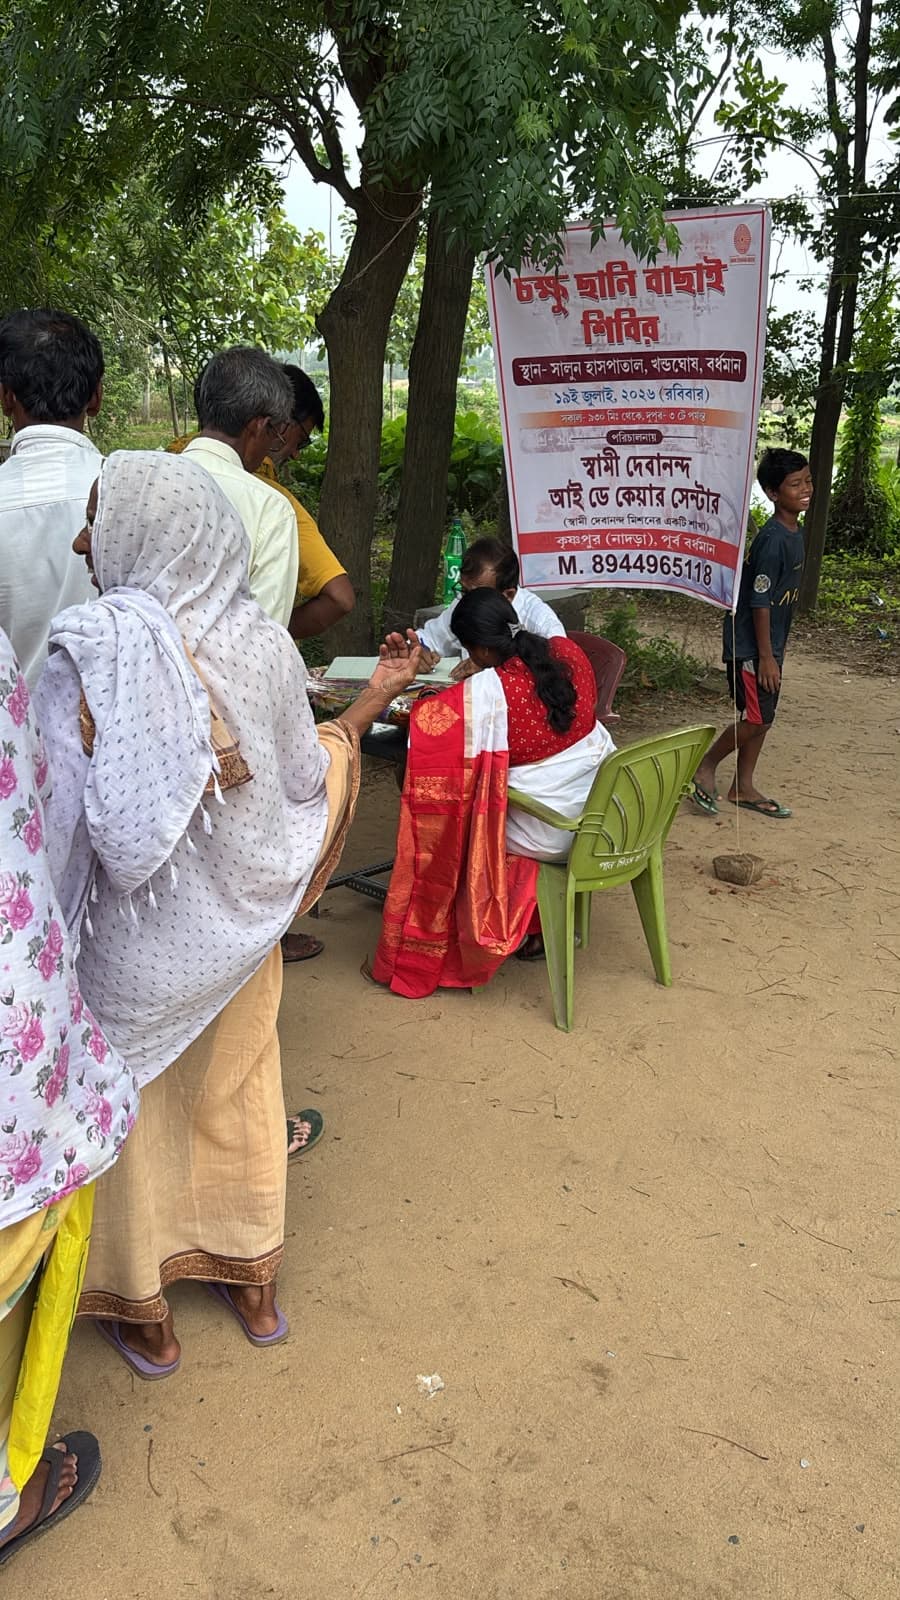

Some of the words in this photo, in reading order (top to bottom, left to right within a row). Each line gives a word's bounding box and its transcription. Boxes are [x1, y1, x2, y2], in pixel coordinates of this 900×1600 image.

[513, 274, 570, 318] চক্ষু
[574, 260, 637, 302] ছানি
[643, 255, 729, 298] বাছাই
[581, 306, 660, 346] শিবির
[518, 361, 548, 383] স্থান-
[550, 360, 583, 381] সালুন
[584, 358, 648, 377] হাসপাতাল,
[705, 351, 742, 376] বর্ধমান
[554, 387, 578, 405] ১৯ই
[581, 386, 617, 408] জুলাই,
[620, 387, 656, 402] ২০২৬
[659, 383, 710, 404] (রবিবার)
[611, 431, 657, 444] পরিচালনায়
[581, 447, 620, 480] স্বামী
[626, 452, 692, 479] দেবানন্দ
[548, 479, 585, 512] আই
[589, 486, 610, 509] ডে
[615, 483, 666, 509] কেয়ার
[671, 481, 721, 515] সেন্টার
[563, 513, 588, 528] (স্বামী
[590, 515, 625, 526] দেবানন্দ
[627, 513, 662, 526] মিশনের
[664, 516, 687, 528] একটি
[555, 533, 601, 549] কৃষ্ণপুর
[684, 537, 717, 556] বর্ধমান
[558, 555, 584, 575] M.
[592, 553, 713, 587] 8944965118
